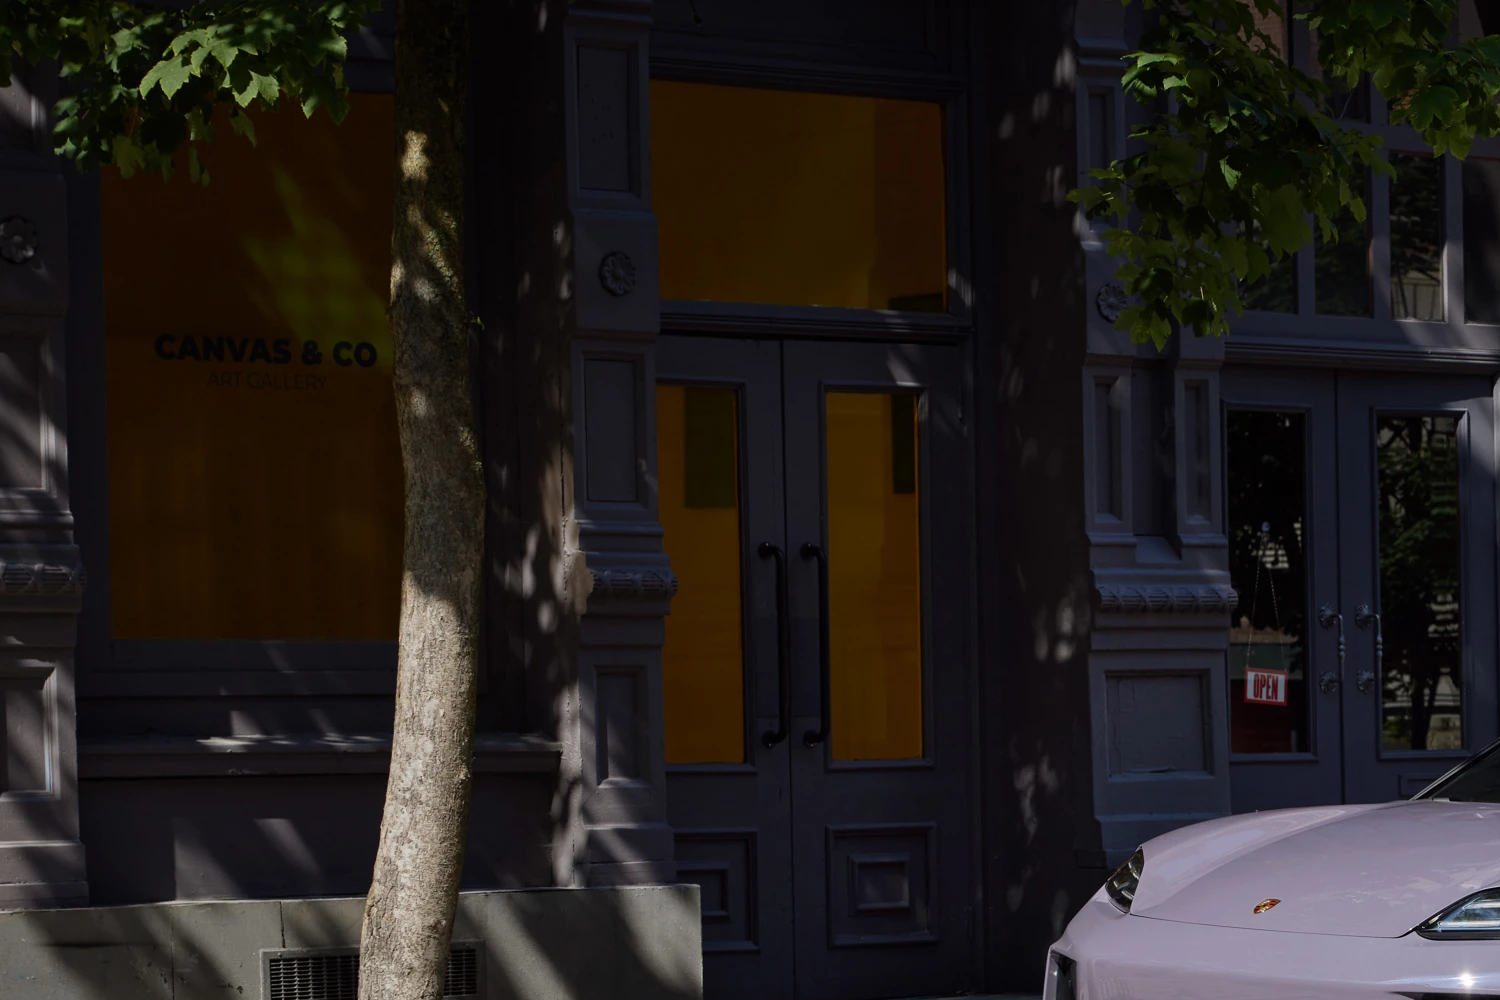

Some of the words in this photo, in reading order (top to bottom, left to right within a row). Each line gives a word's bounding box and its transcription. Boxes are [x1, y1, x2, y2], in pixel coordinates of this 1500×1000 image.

[154, 333, 292, 365] CANVAS
[301, 339, 323, 366] &
[332, 340, 378, 368] CO
[206, 371, 241, 388] ART
[247, 371, 328, 391] GALLERY
[1253, 673, 1279, 700] OPEN
